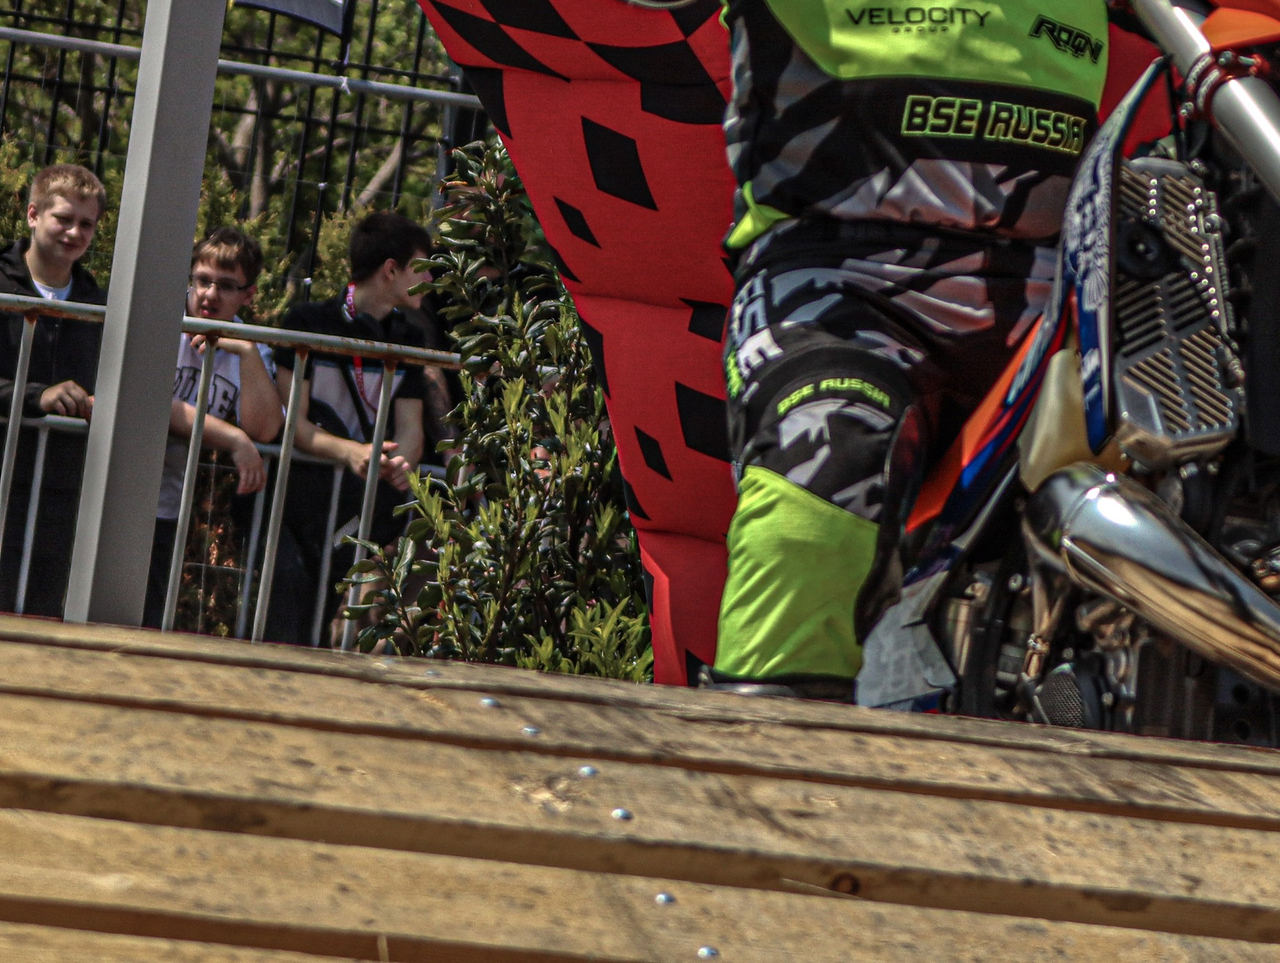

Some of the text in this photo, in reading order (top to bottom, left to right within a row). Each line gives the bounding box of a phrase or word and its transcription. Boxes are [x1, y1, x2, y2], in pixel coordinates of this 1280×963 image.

[845, 7, 991, 27] VELOCITY
[901, 94, 1087, 154] BSE RUSSIA
[777, 383, 815, 415] BSE
